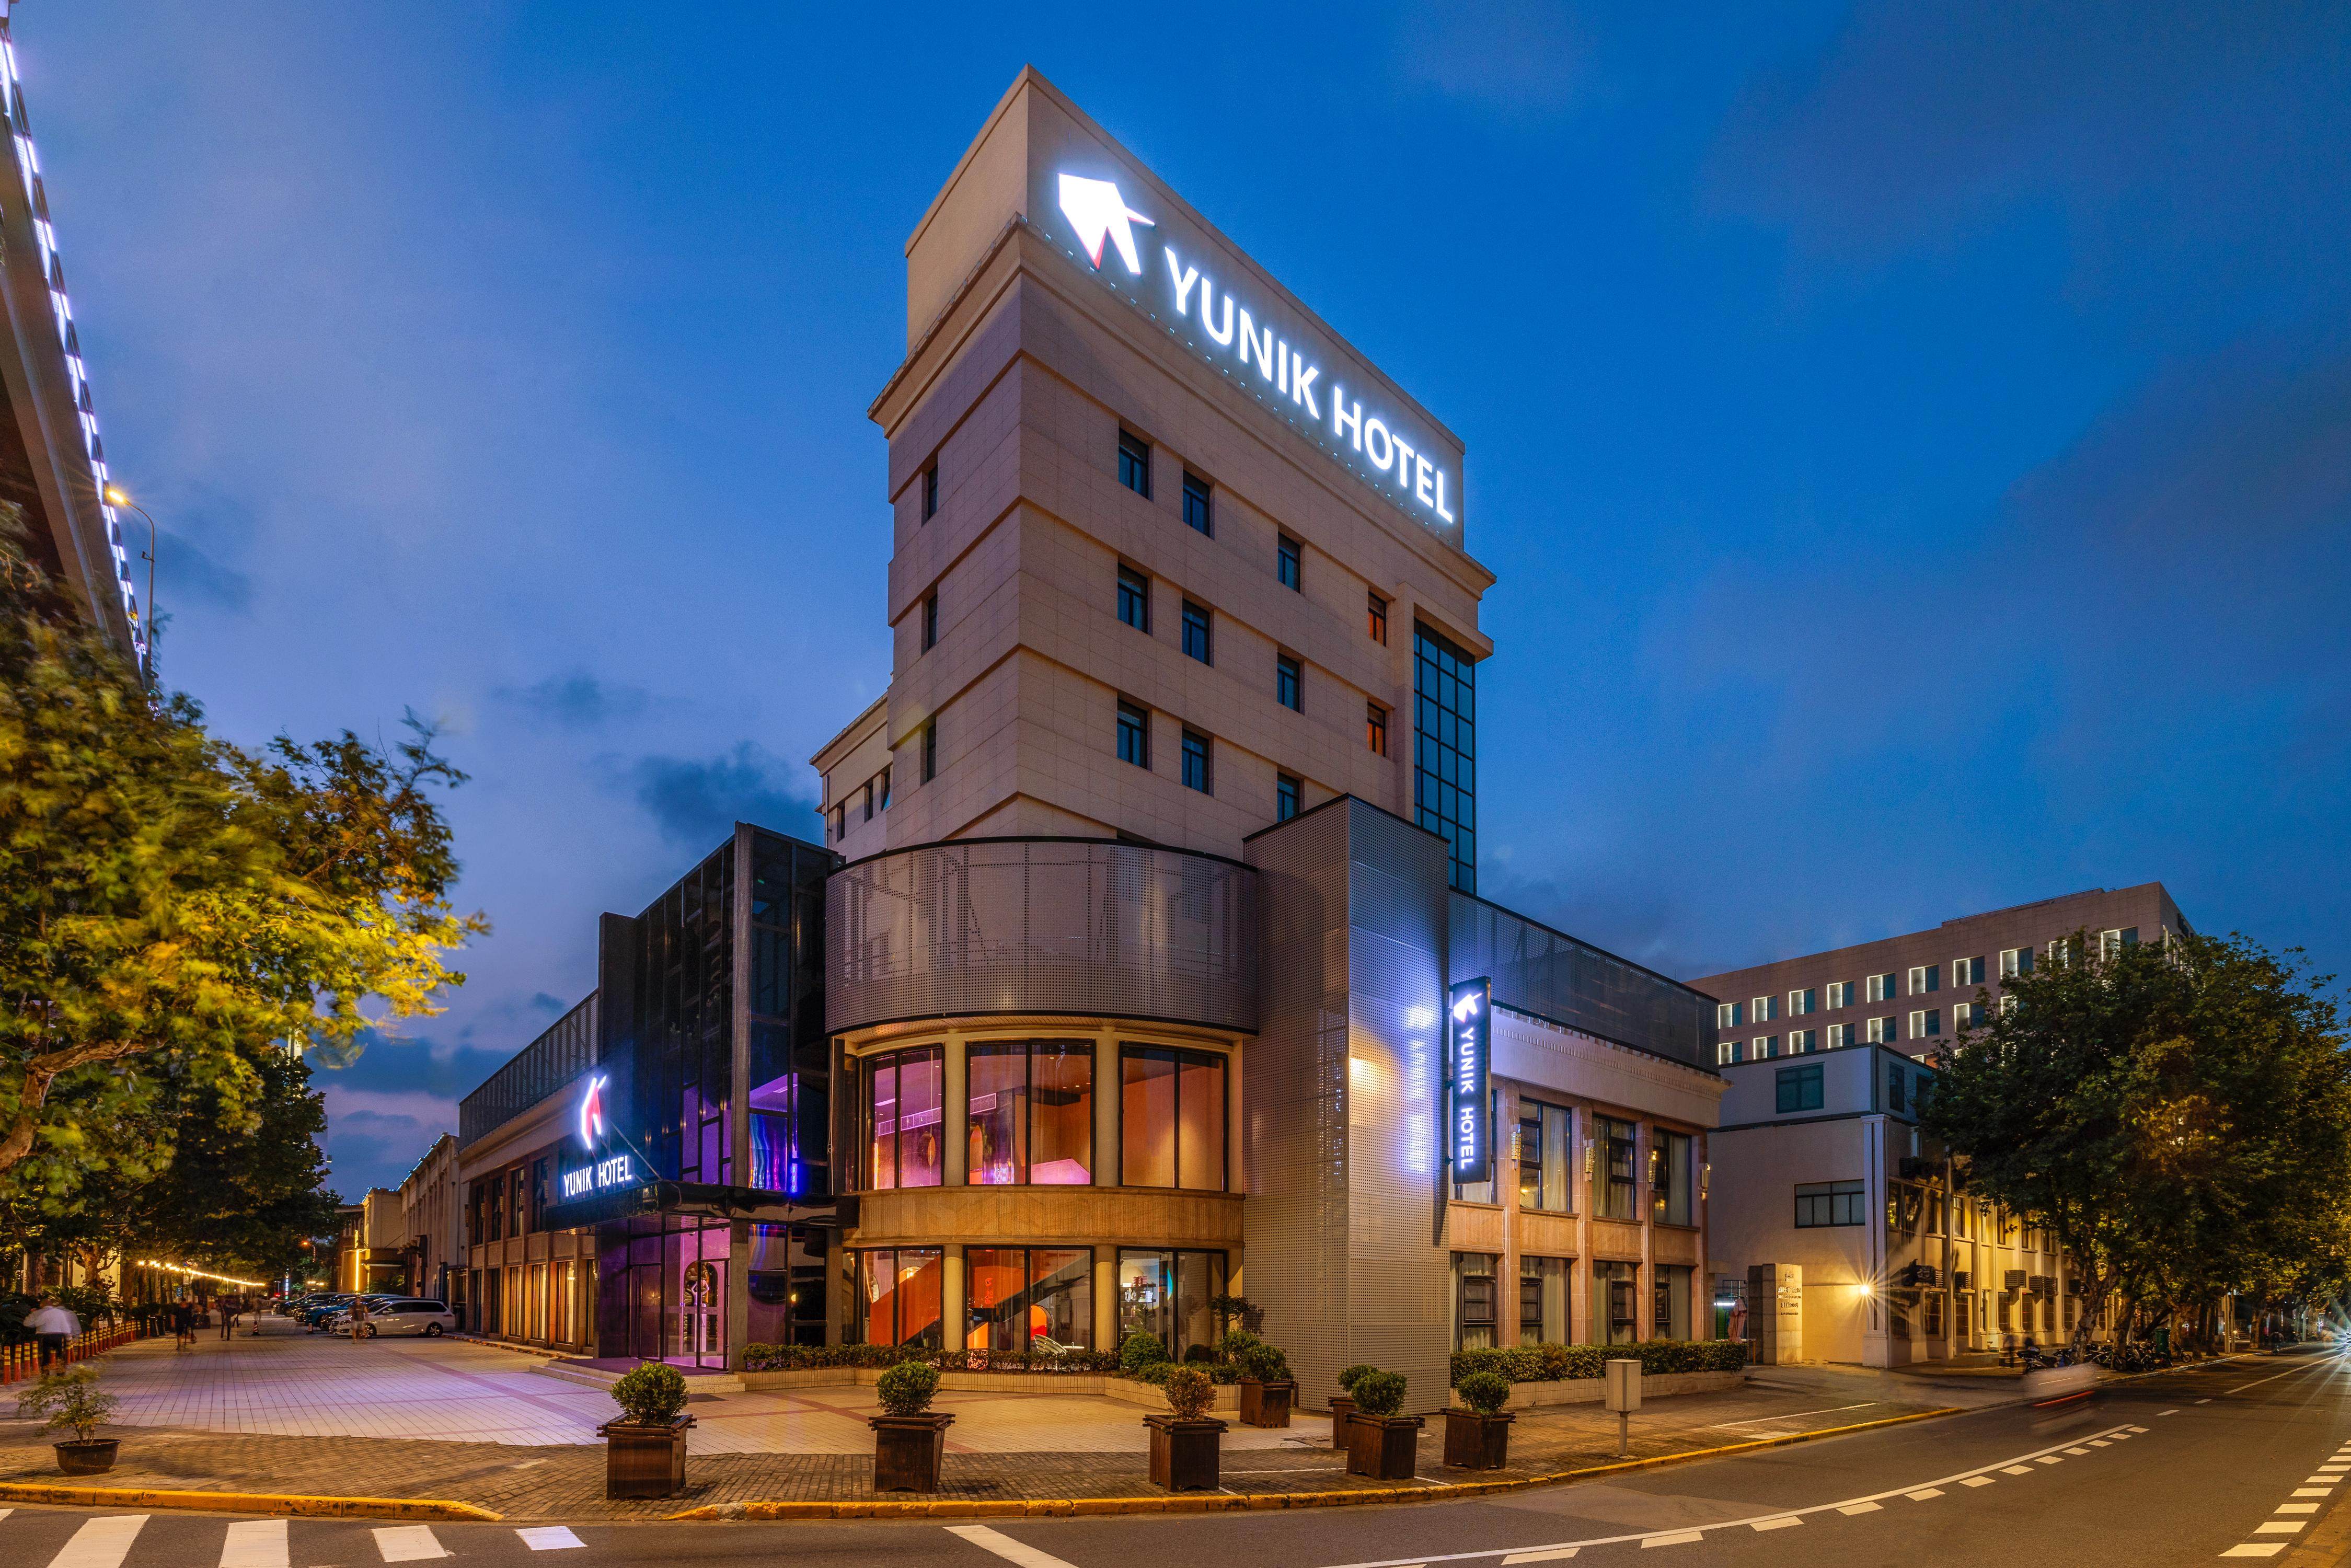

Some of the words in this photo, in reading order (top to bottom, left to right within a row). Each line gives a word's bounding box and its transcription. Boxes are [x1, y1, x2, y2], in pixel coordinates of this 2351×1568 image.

[1164, 246, 1320, 420] YUNIK
[1333, 385, 1453, 524] HOTEL
[1460, 1027, 1474, 1094] YUNIK
[1460, 1107, 1474, 1170] HOTEL
[563, 1166, 593, 1197] YUNIK
[598, 1155, 632, 1187] HOTEL
